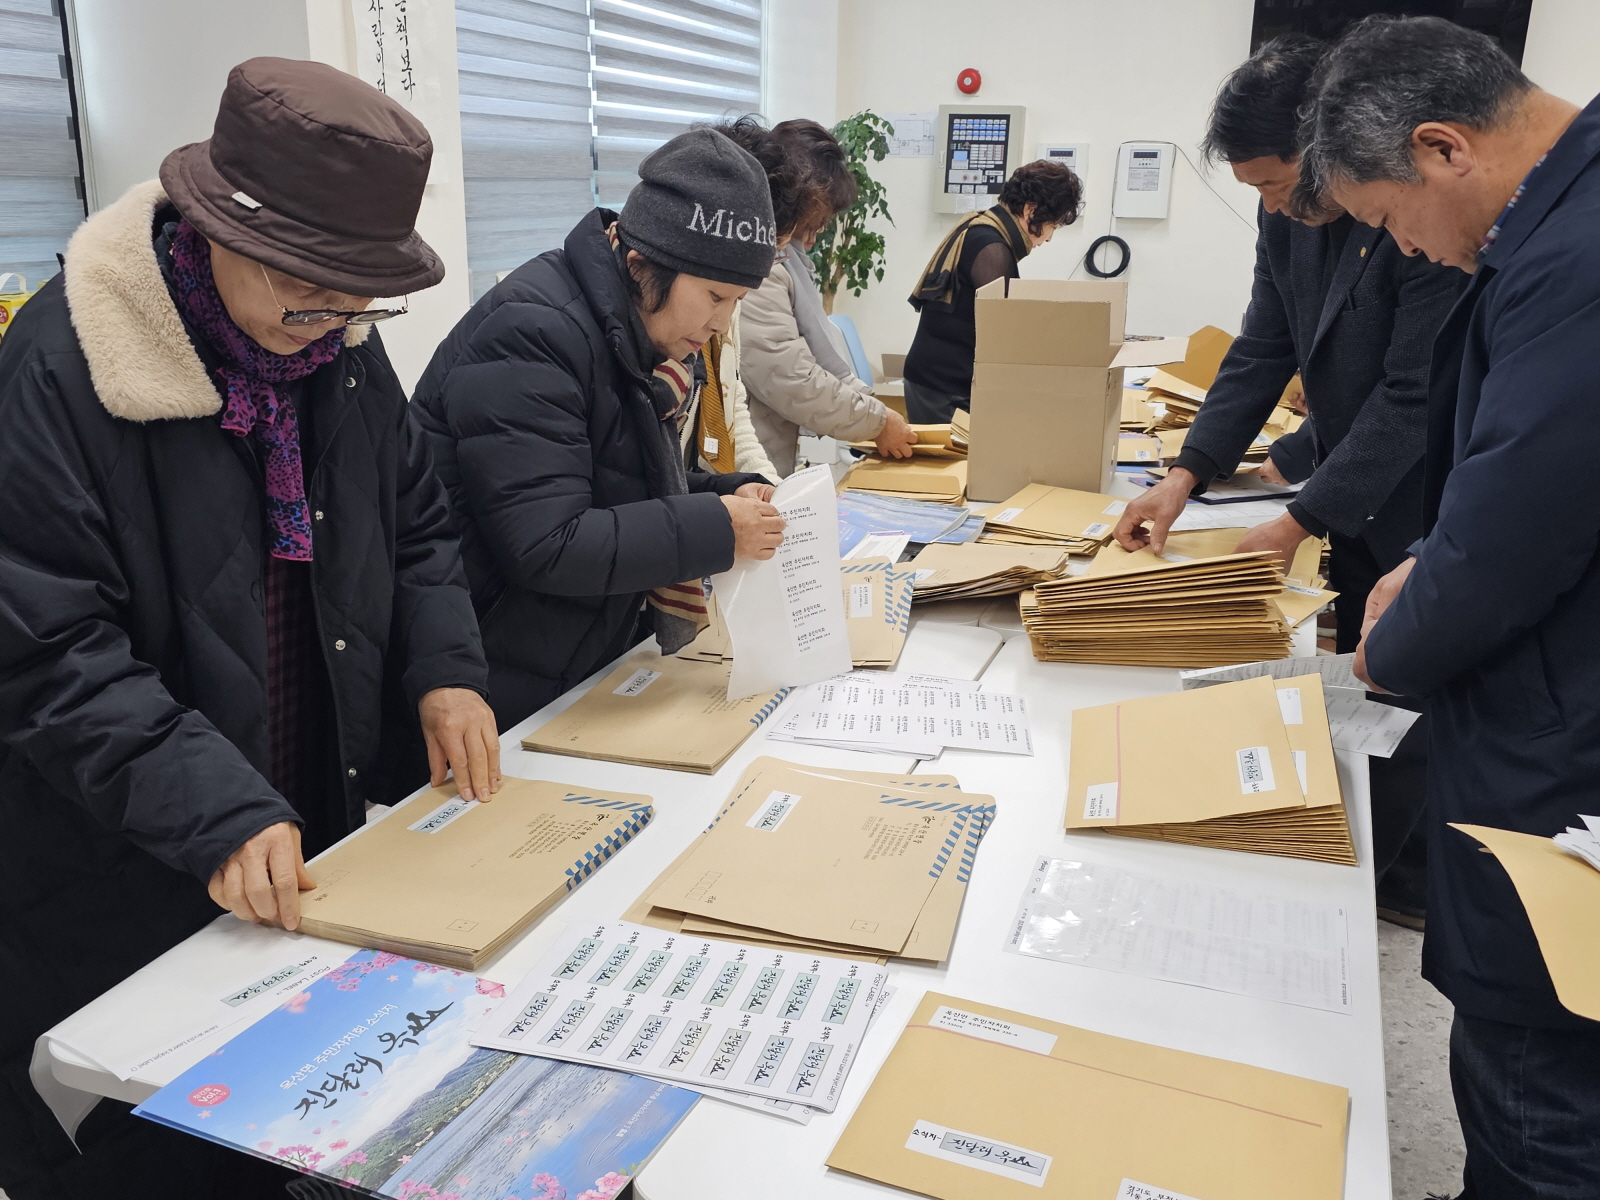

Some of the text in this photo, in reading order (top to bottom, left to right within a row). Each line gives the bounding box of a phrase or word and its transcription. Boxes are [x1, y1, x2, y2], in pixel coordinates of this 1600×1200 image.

[279, 1003, 399, 1090] 옥산면 주민자치회 소식지
[293, 1051, 384, 1121] 진달래
[947, 1138, 994, 1158] 진달래
